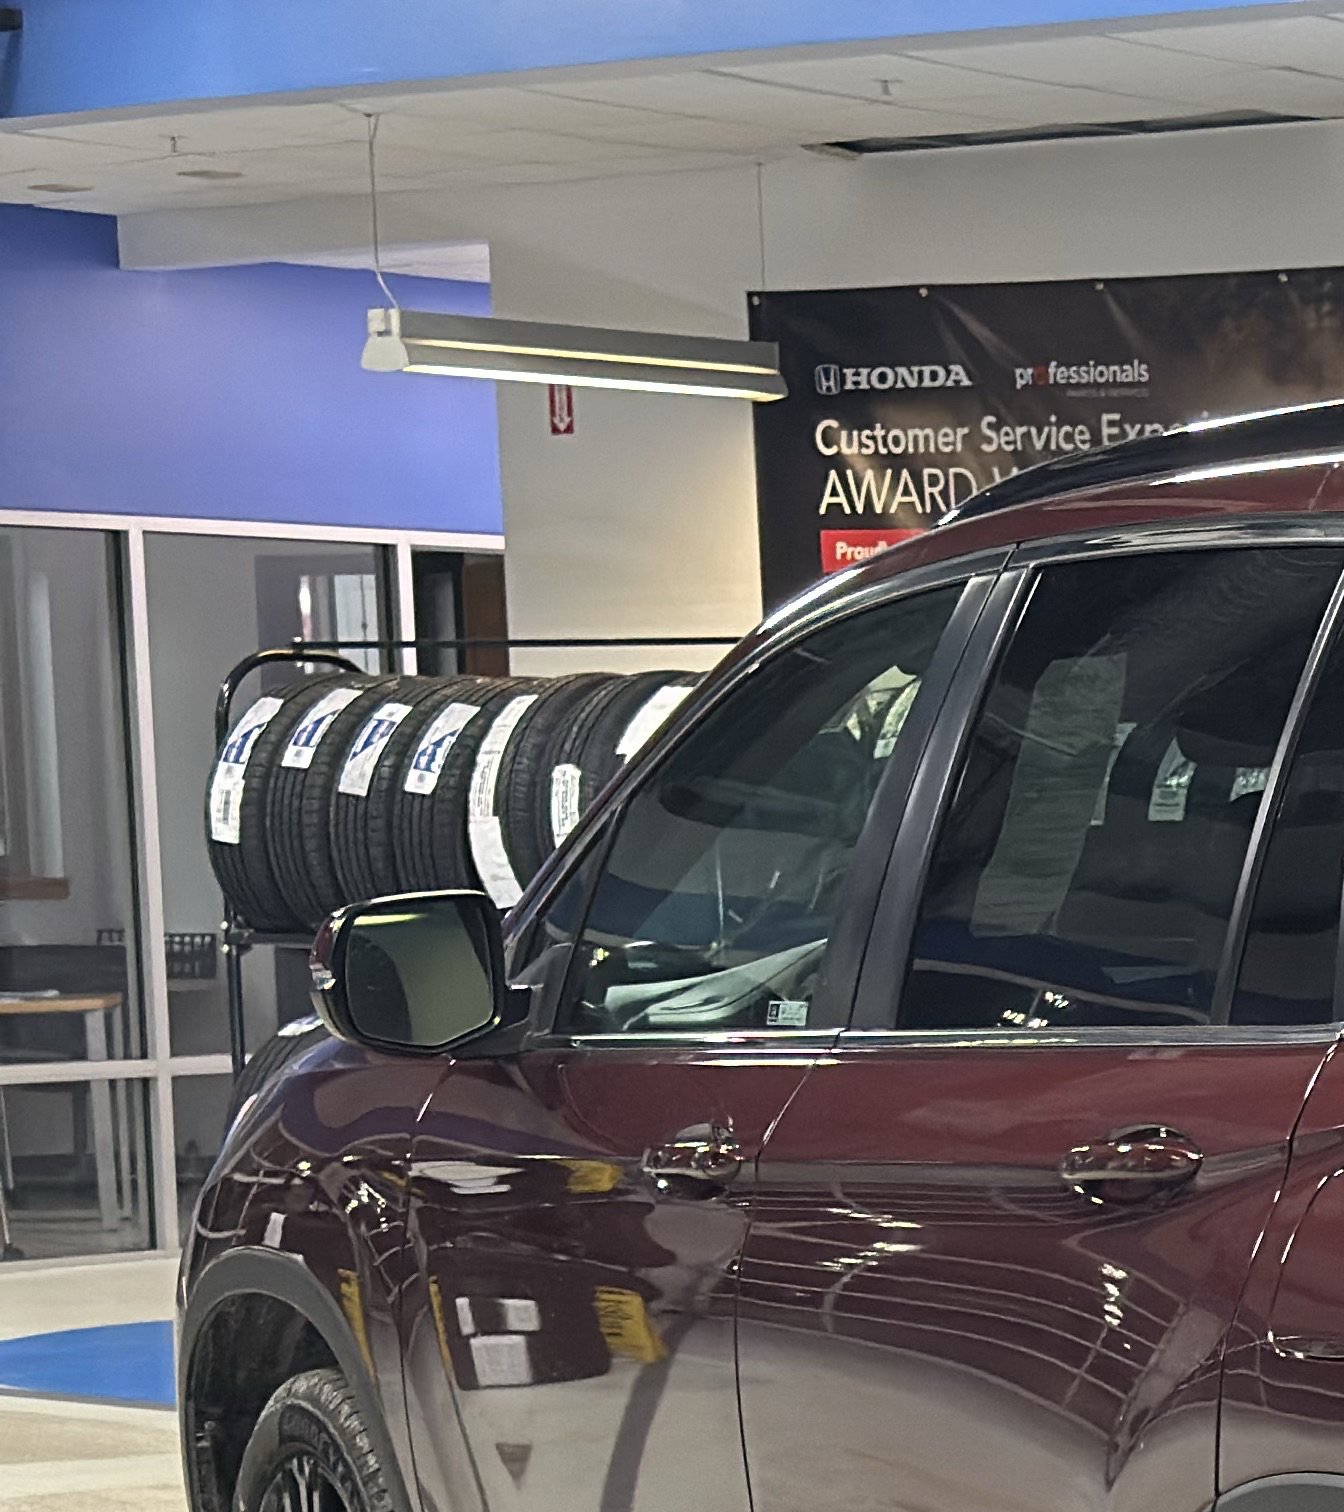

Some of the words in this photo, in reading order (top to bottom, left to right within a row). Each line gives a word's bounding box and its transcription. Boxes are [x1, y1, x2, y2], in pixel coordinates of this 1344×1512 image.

[842, 364, 973, 390] HONDA
[1015, 359, 1149, 389] professionals
[815, 419, 969, 456] Customer
[980, 415, 1091, 452] Service
[819, 467, 978, 515] AWARD
